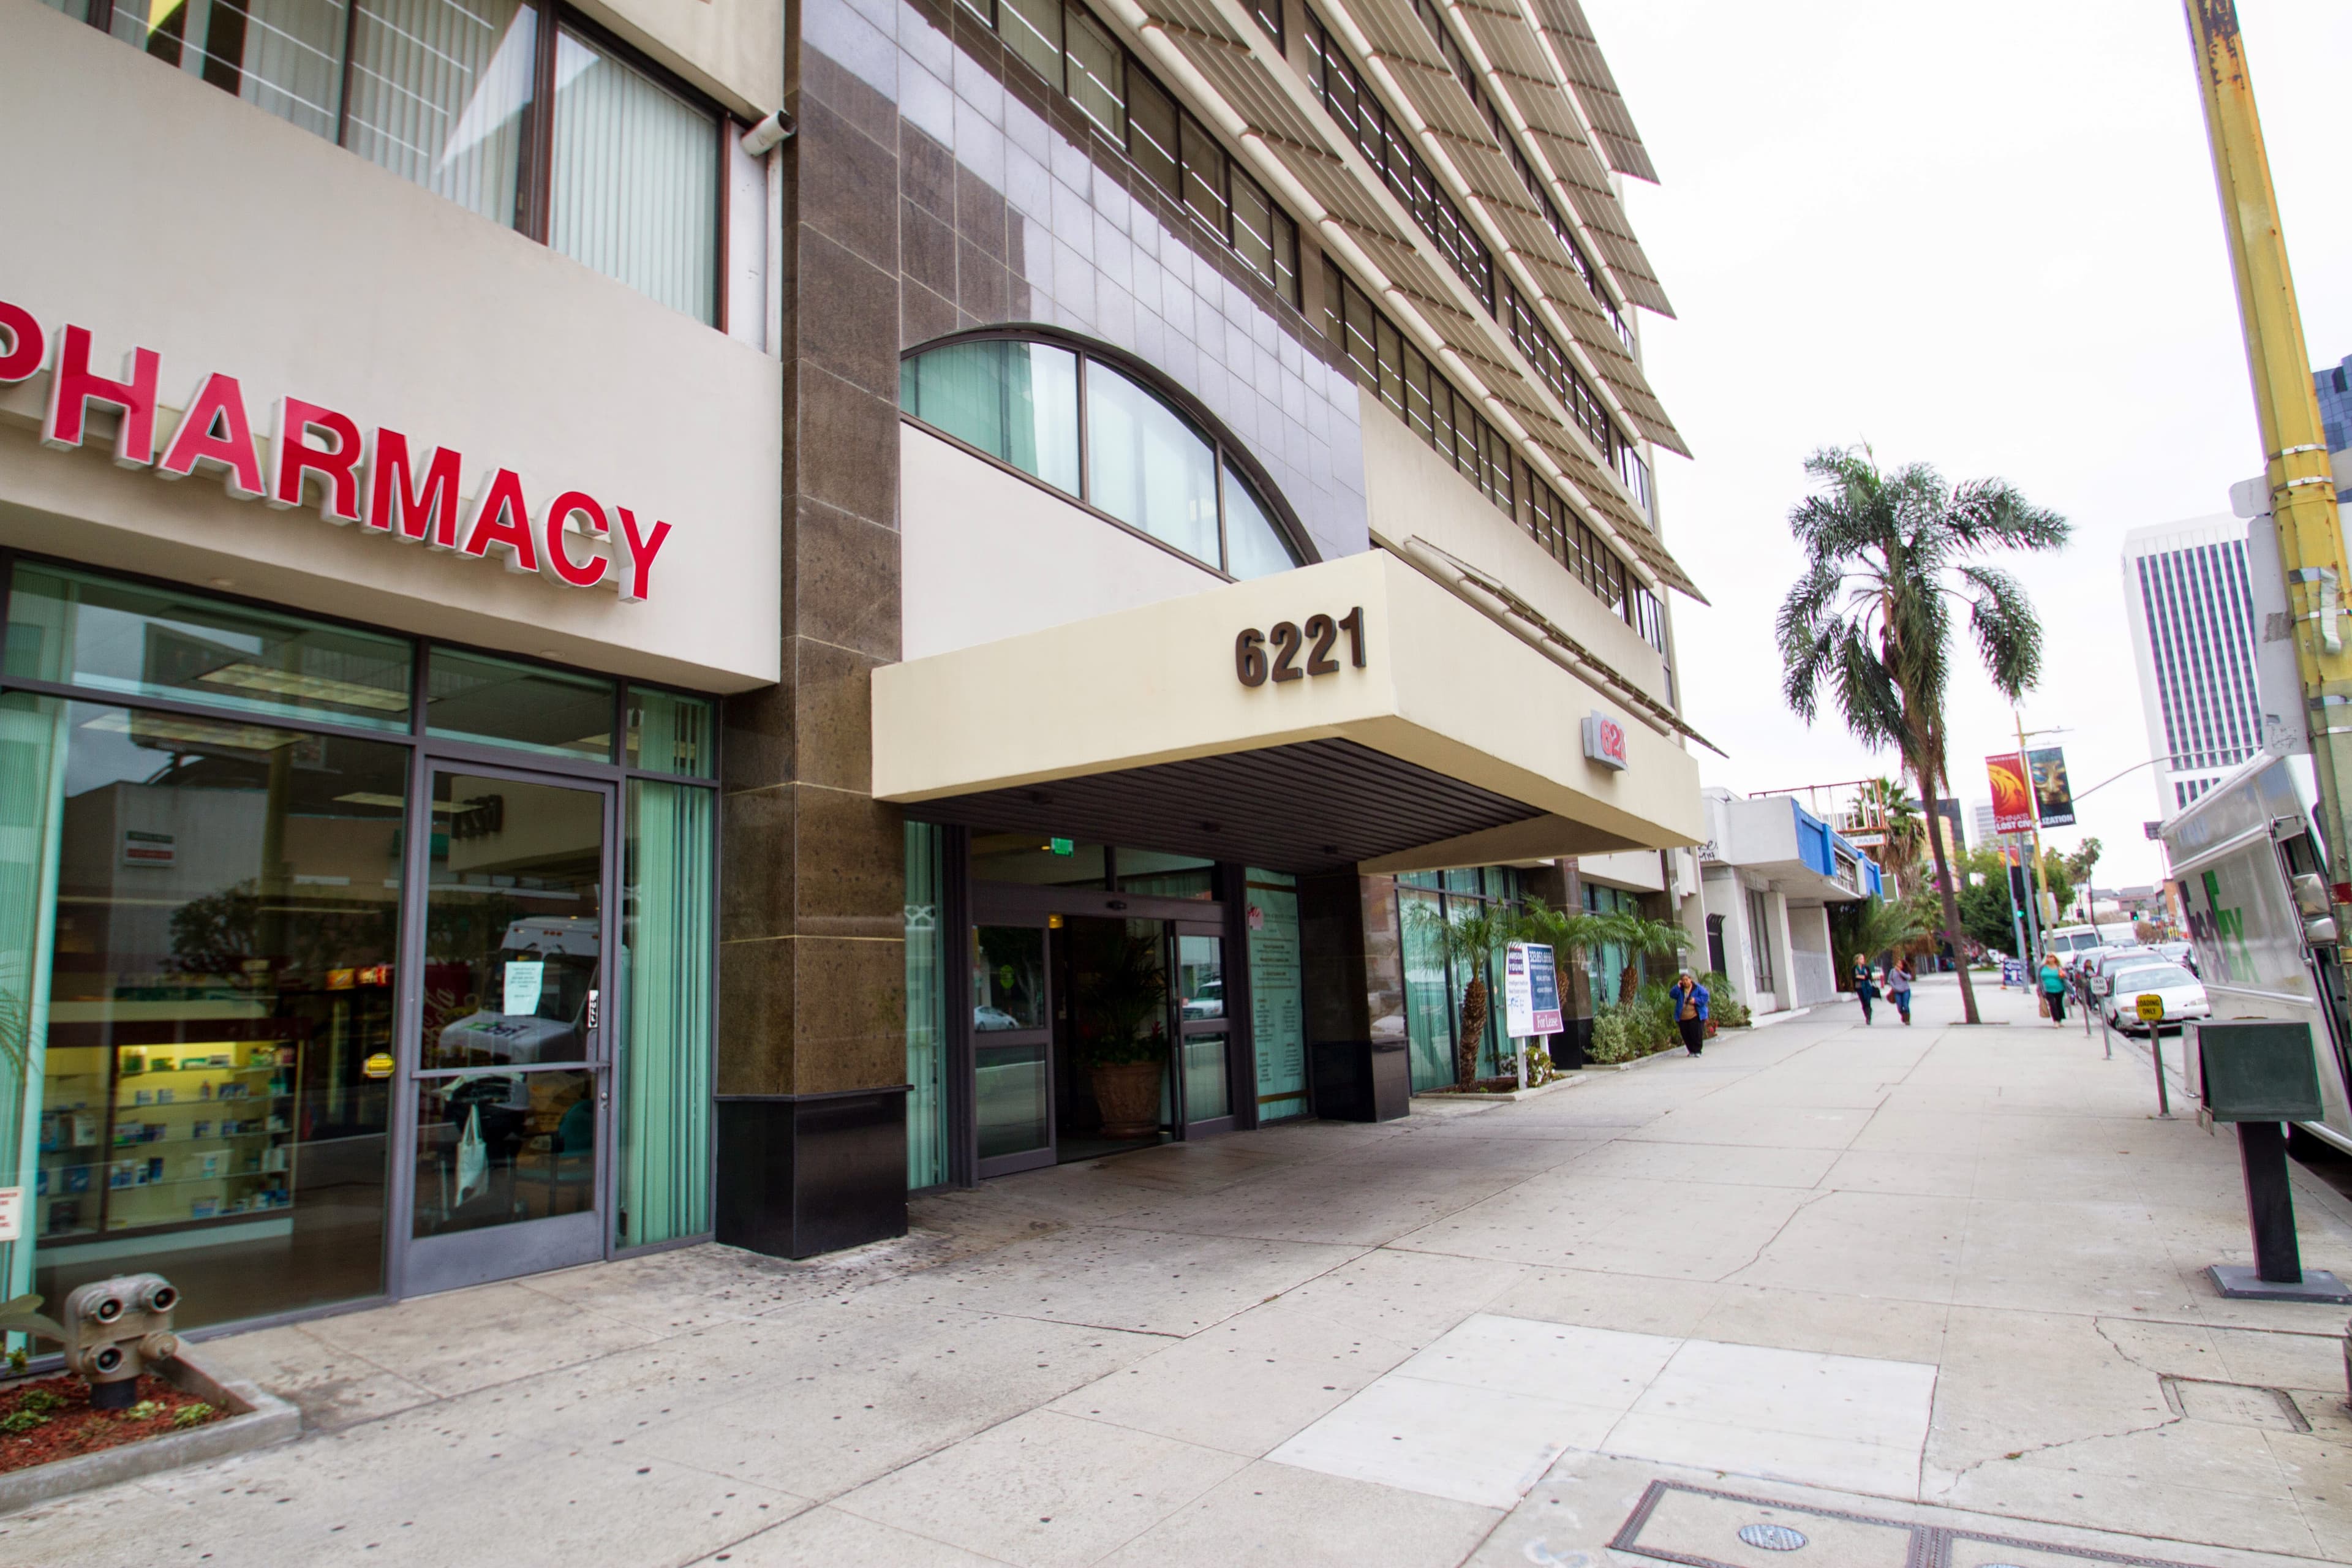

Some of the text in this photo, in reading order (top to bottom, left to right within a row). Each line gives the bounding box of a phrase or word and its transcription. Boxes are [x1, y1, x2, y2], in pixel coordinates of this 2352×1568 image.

[1235, 606, 1366, 687] 6221
[1996, 813, 2029, 823] CHINA'S
[1996, 821, 2017, 831] LOST
[2177, 869, 2261, 984] FedEx
[1537, 1014, 1558, 1029] For Lease
